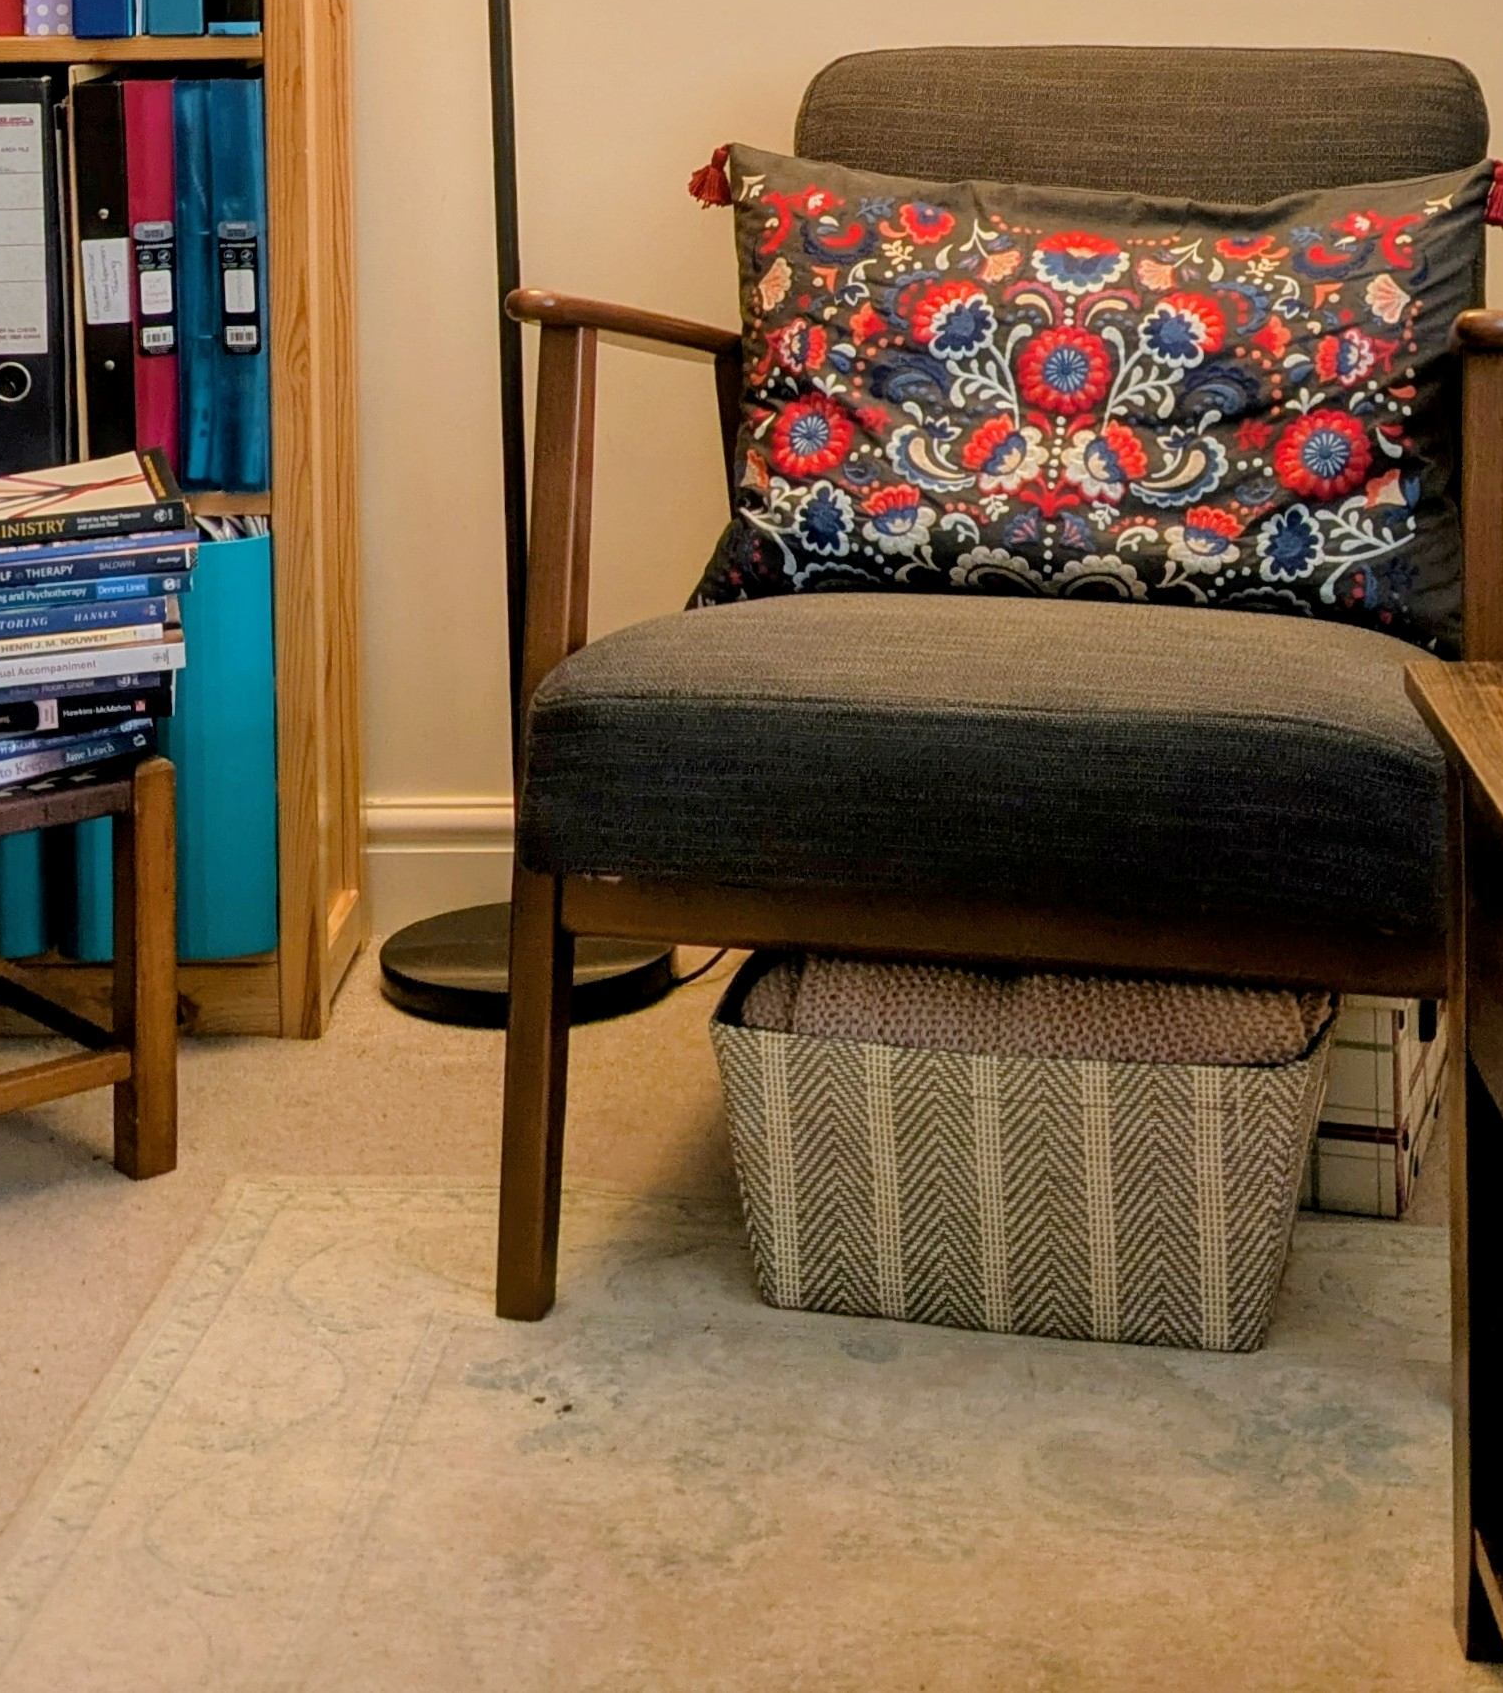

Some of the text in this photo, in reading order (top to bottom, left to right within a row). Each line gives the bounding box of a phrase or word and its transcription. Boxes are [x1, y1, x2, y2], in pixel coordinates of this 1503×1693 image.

[25, 565, 74, 579] THERAPY
[98, 560, 136, 571] BALDWIN
[8, 590, 25, 601] and
[26, 586, 87, 603] Psychotherapy
[98, 582, 125, 595] Dennis
[126, 580, 146, 592] Lines
[73, 611, 118, 623] HANSEN
[0, 642, 35, 654] HENRI
[61, 634, 108, 646] NOUWEN
[17, 661, 97, 677] Accompaniment
[64, 750, 86, 764] Jane
